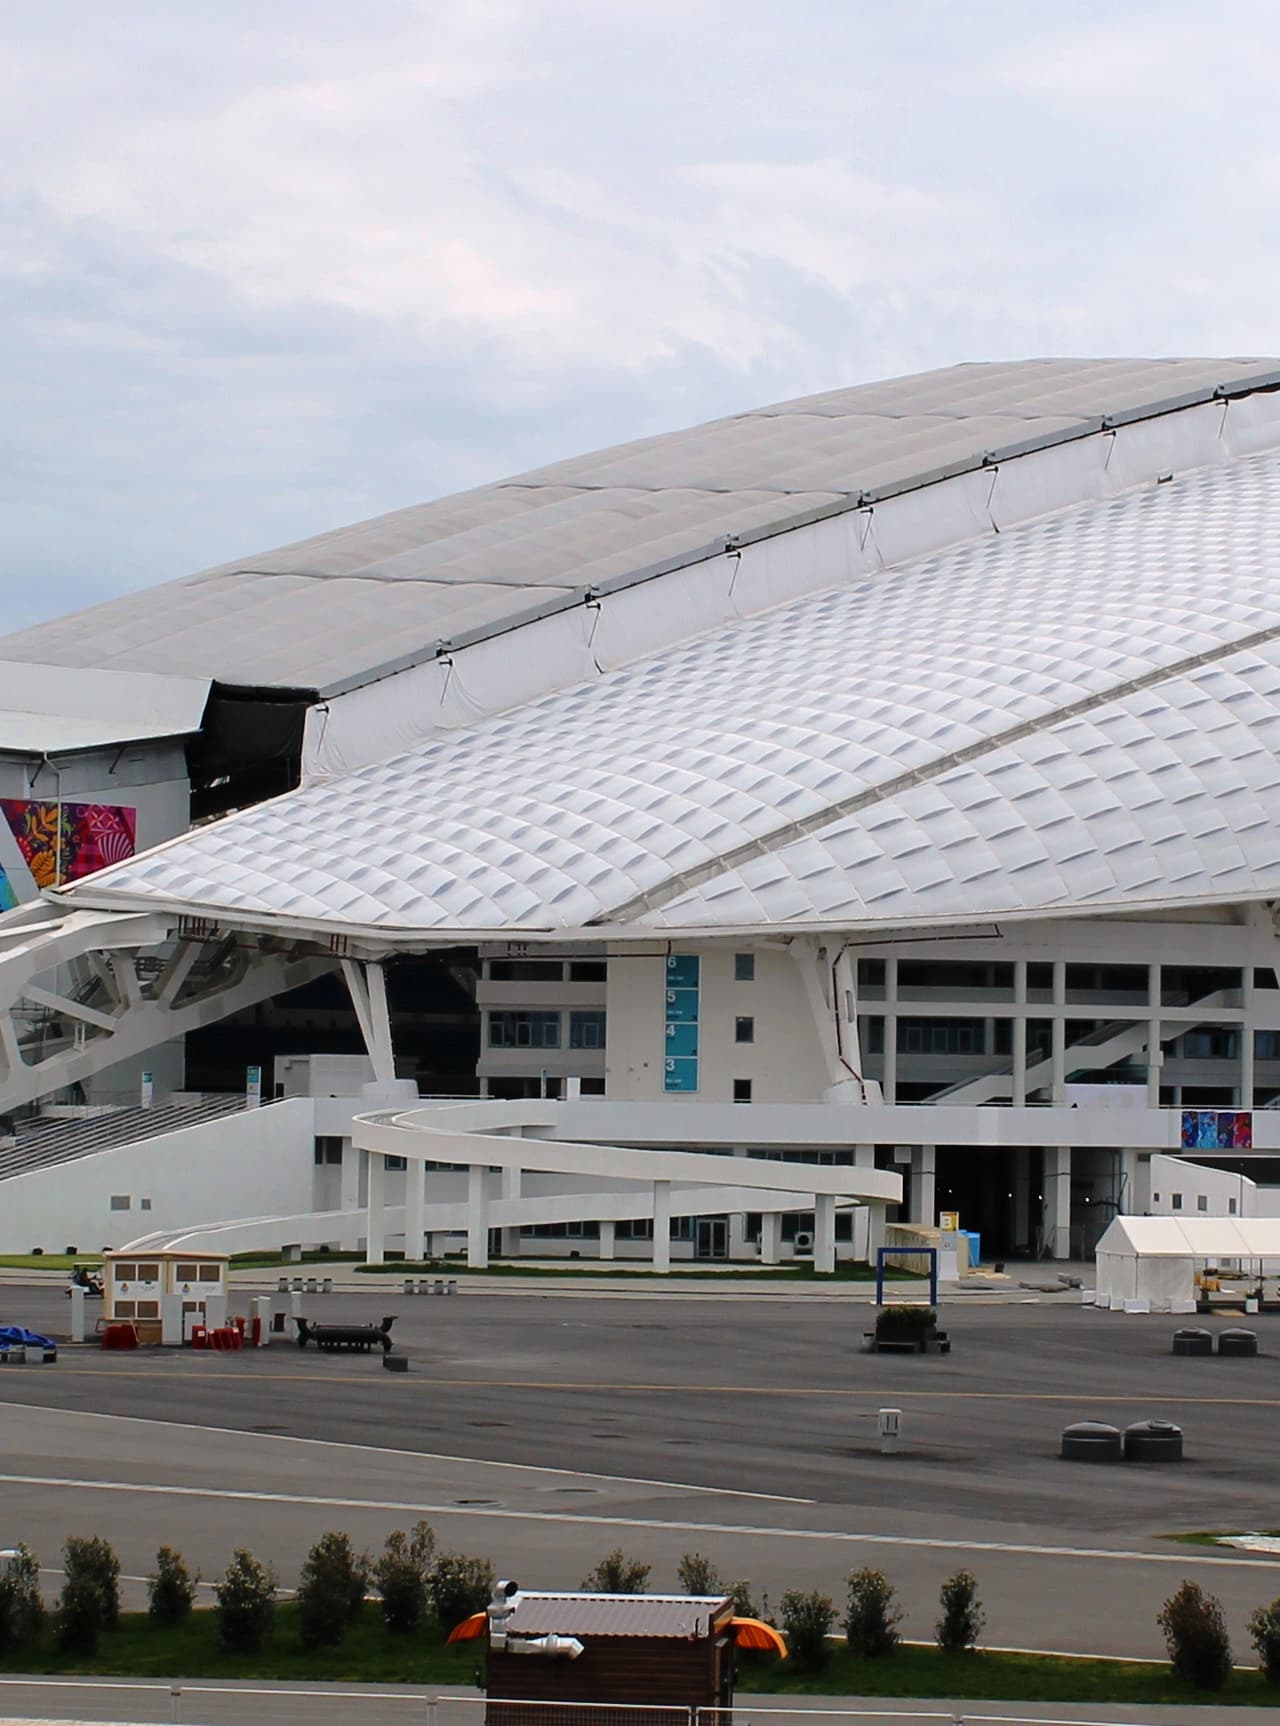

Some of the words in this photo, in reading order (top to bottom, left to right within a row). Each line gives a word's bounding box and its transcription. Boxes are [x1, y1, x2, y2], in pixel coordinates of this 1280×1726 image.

[667, 957, 677, 968] 6
[667, 990, 676, 1002] 5
[666, 1025, 676, 1036] 4
[666, 1059, 675, 1071] 3
